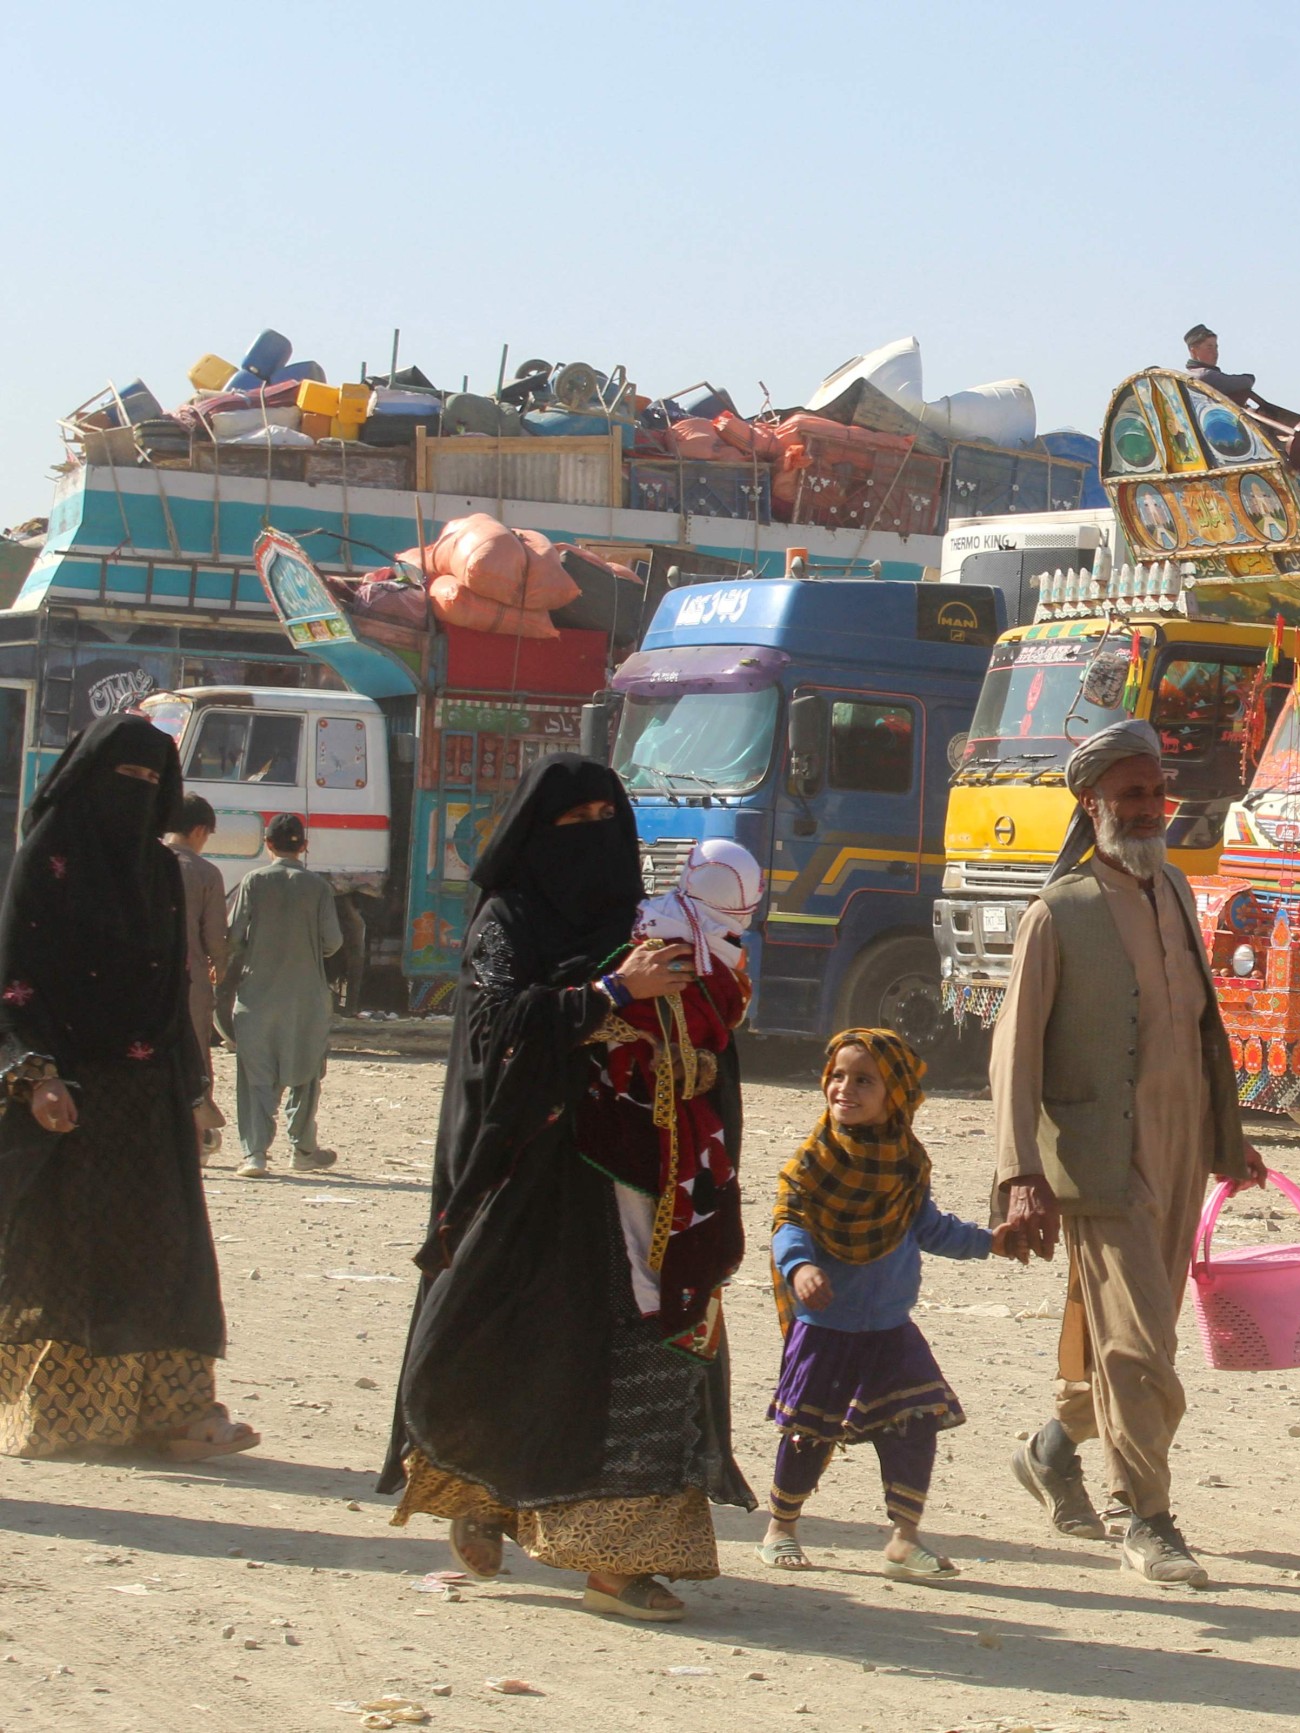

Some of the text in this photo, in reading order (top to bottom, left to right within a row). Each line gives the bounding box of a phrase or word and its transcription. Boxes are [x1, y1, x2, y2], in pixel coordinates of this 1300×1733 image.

[950, 534, 1010, 551] THERMO KING
[940, 616, 976, 628] MAN
